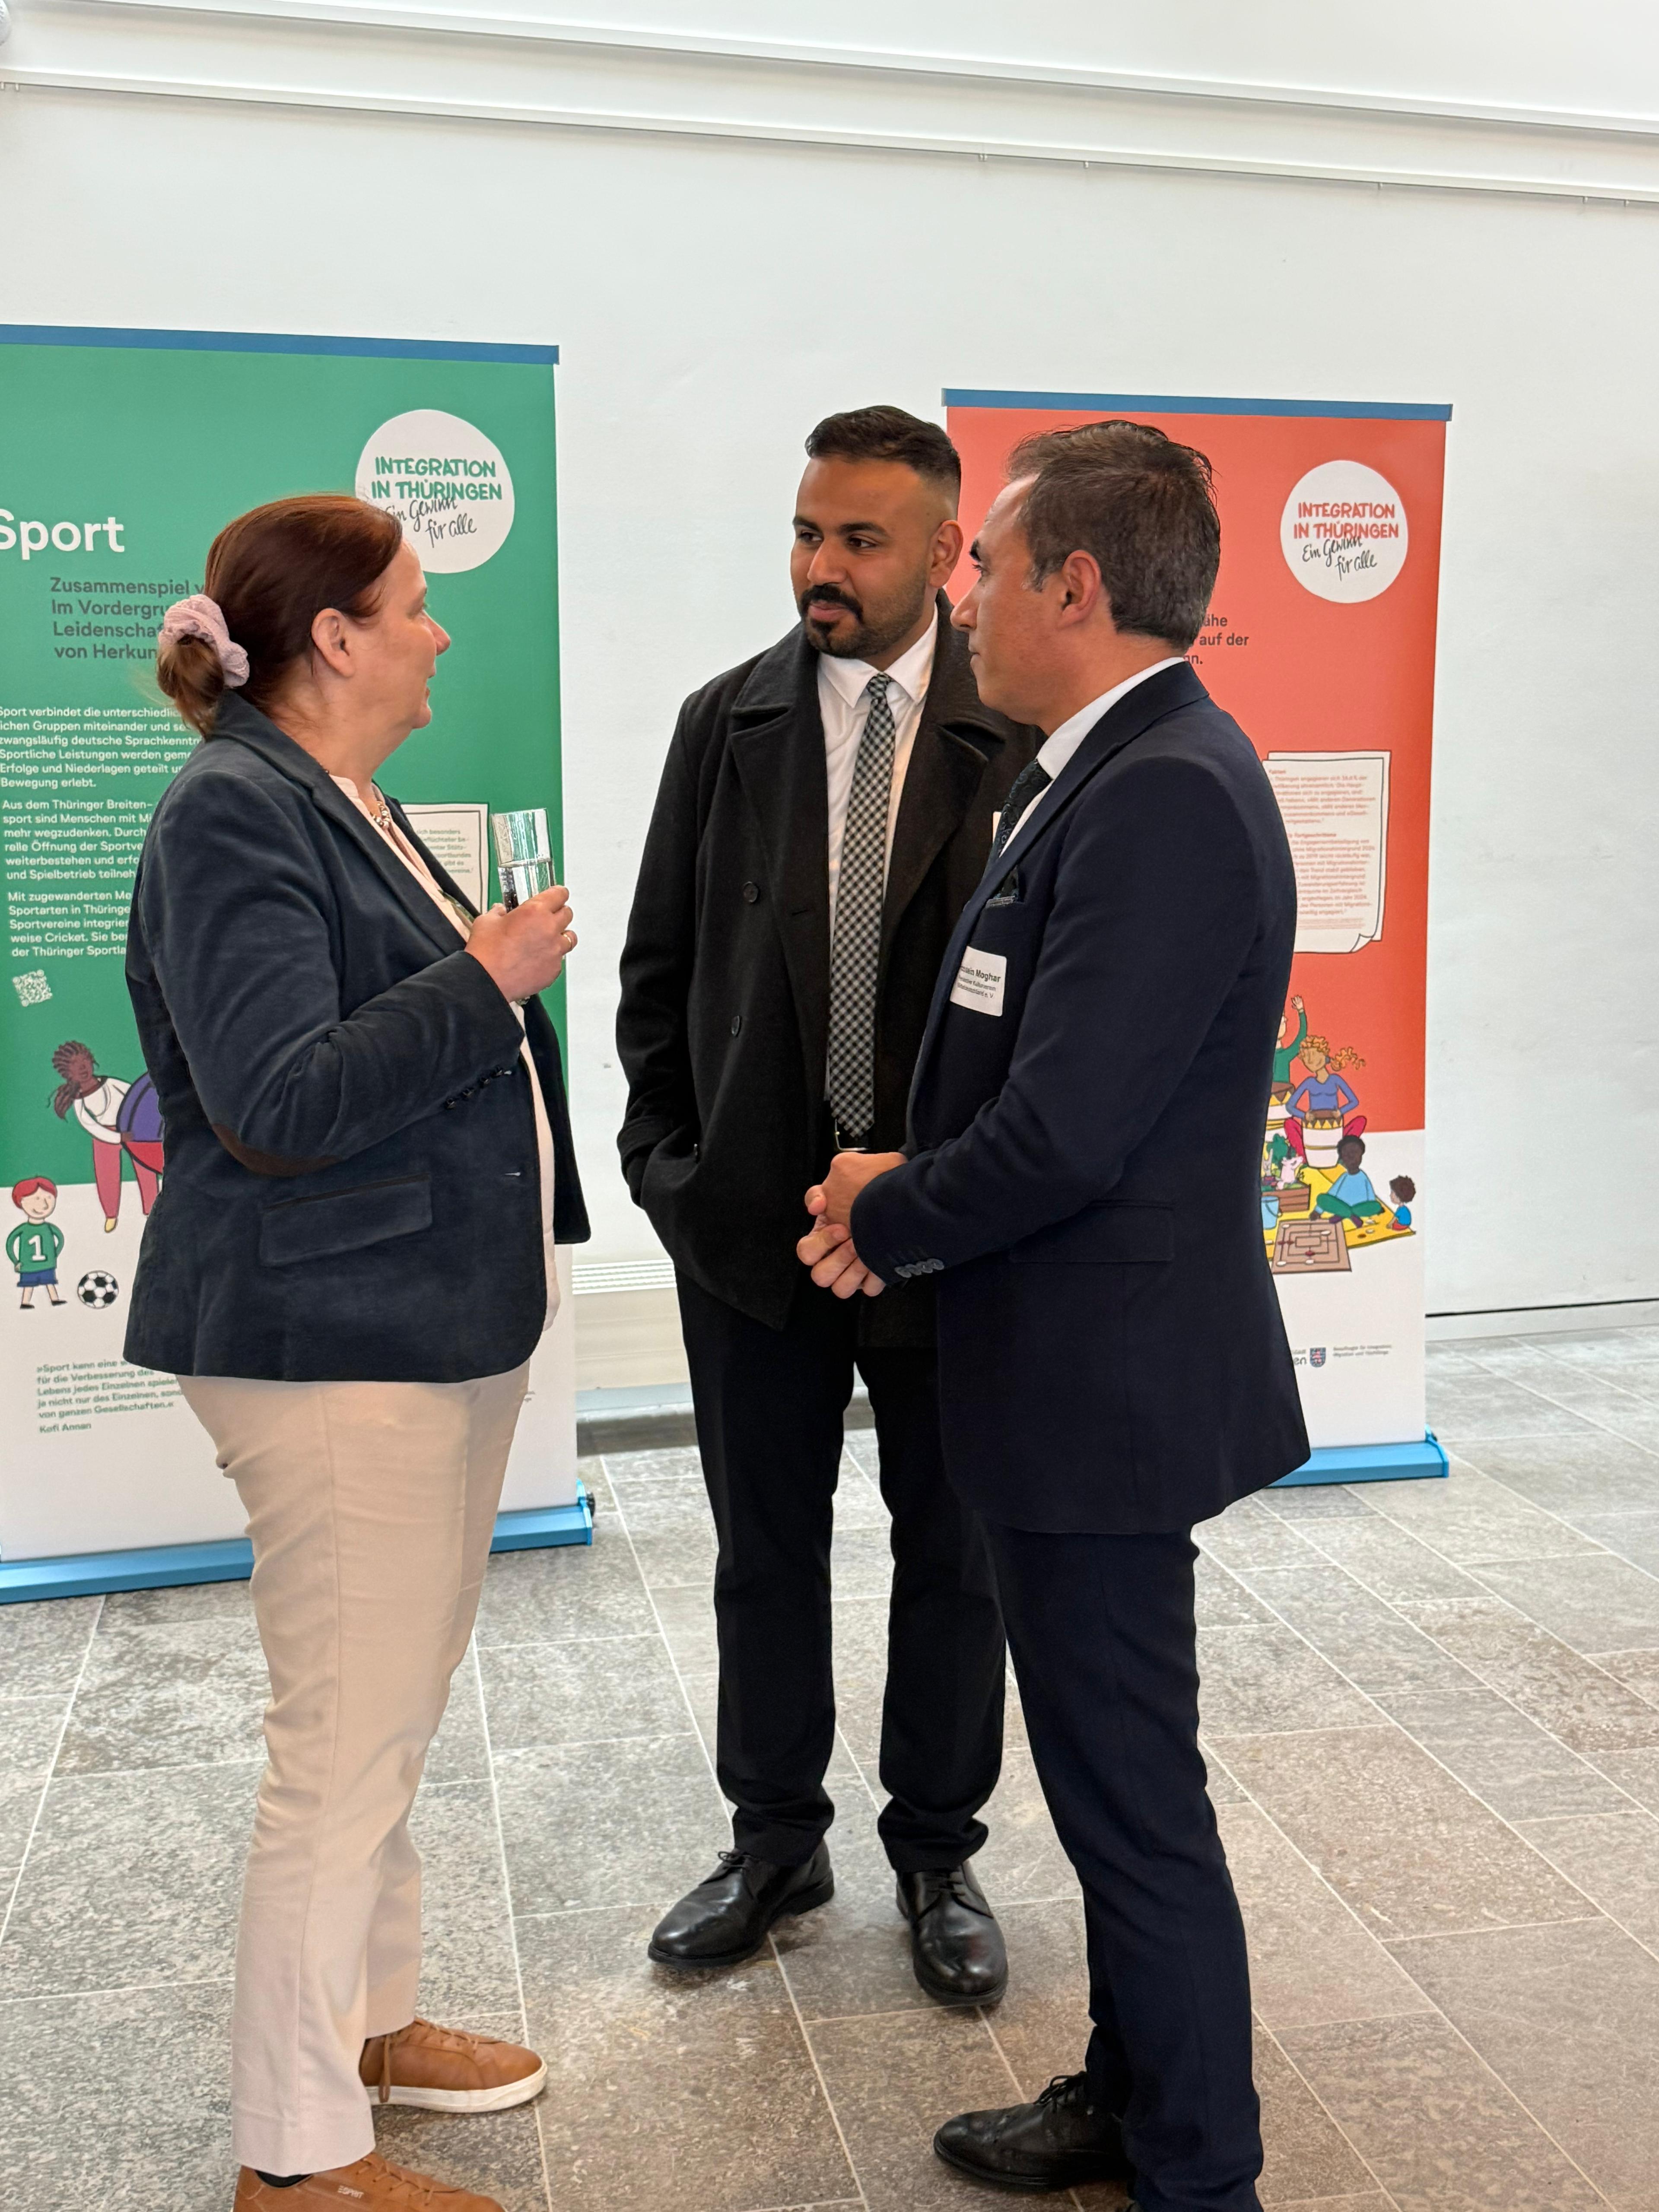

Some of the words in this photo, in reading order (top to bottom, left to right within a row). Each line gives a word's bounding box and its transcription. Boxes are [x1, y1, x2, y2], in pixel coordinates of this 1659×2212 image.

[375, 456, 496, 477] INTEGRATION
[372, 480, 391, 499] IN
[395, 479, 502, 500] THÜRINGEN
[410, 496, 458, 532] Gewinn
[1298, 502, 1395, 518] INTEGRATION
[449, 513, 477, 537] alle
[1294, 523, 1309, 539] IN
[1313, 521, 1398, 539] THÜRINGEN
[0, 509, 125, 560] Sport
[1302, 544, 1321, 562] Ein
[1323, 535, 1363, 567] Gewinn
[1354, 550, 1377, 571] alle
[50, 577, 189, 597] Zusammenspiel
[52, 599, 73, 614] Im
[1199, 632, 1222, 645] auf
[1226, 632, 1249, 645] der
[55, 647, 87, 658] von
[29, 707, 81, 717] verbindet
[84, 707, 101, 717] die
[33, 721, 81, 733] Gruppen
[83, 721, 148, 731] miteinander
[150, 722, 170, 731] und
[0, 735, 68, 747] zwangsläufig
[71, 735, 122, 745] deutsche
[0, 749, 56, 761] Sportliche
[59, 749, 118, 761] Leistungen
[121, 750, 161, 759] werden
[0, 763, 39, 775] Erfolge
[42, 764, 62, 773] und
[66, 763, 130, 775] Niederlagen
[133, 763, 169, 775] geteilt
[1, 777, 58, 789] Bewegung
[61, 778, 96, 787] erlebt.
[2, 800, 22, 809] Aus
[25, 800, 49, 809] dem
[52, 799, 104, 811] Thüringer
[107, 799, 153, 809] Breiten-
[3, 815, 32, 825] sport
[35, 814, 57, 823] sind
[60, 814, 116, 823] Menschen
[119, 814, 136, 823] mit
[4, 828, 31, 837] mehr
[34, 827, 111, 839] wegzudenken.
[114, 827, 146, 837] Durch
[5, 842, 29, 852] relle
[32, 839, 77, 853] Öffnung
[79, 842, 98, 851] der
[100, 841, 143, 852] Sportve
[6, 855, 91, 865] weiterbestehen
[94, 855, 114, 864] und
[6, 870, 27, 880] und
[30, 869, 96, 881] Spielbetrieb
[8, 892, 26, 901] Mit
[29, 891, 112, 903] zugewanderten
[9, 905, 68, 917] Sportarten
[71, 905, 81, 914] in
[10, 918, 80, 931] Sportvereine
[11, 933, 42, 943] weise
[45, 932, 88, 942] Cricket.
[91, 931, 108, 941] Sie
[12, 947, 29, 957] der
[32, 946, 84, 958] Thüringer
[29, 1234, 46, 1261] 1
